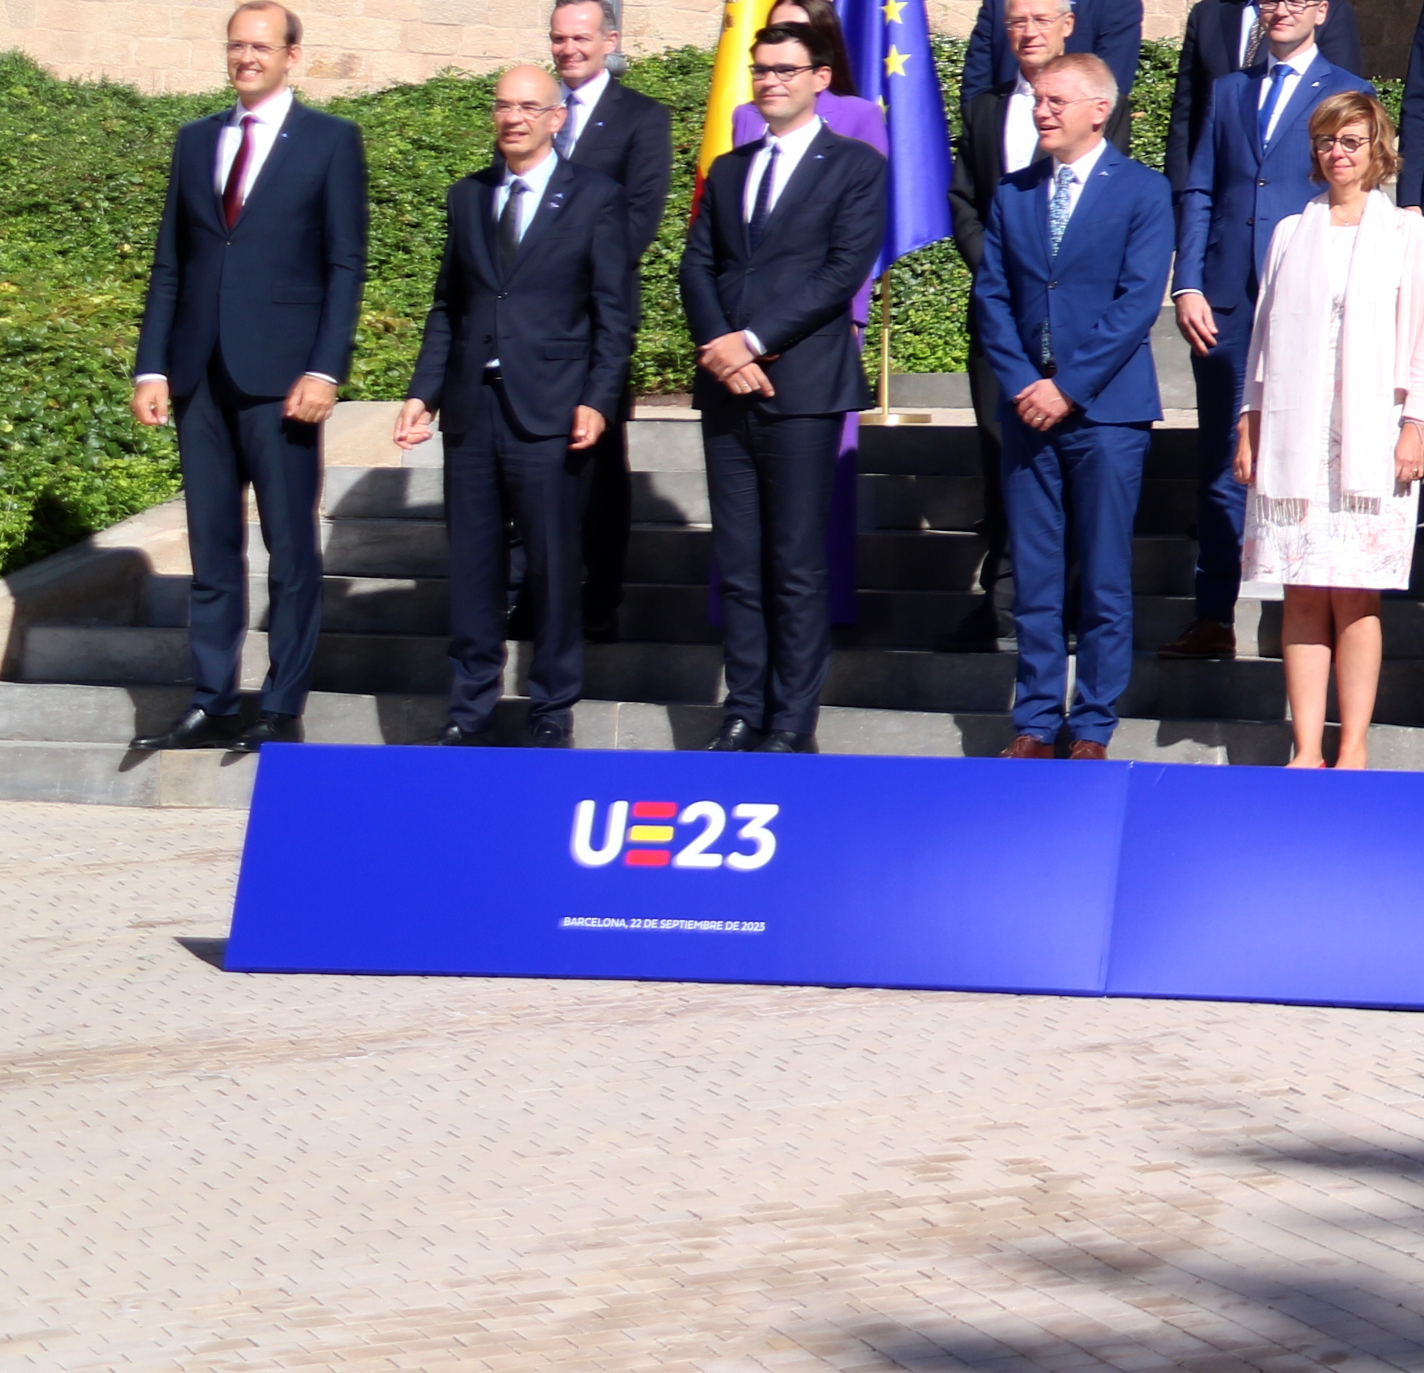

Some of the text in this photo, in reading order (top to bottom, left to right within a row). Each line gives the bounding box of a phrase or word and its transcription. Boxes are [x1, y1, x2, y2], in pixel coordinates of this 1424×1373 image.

[571, 799, 780, 870] UE23
[562, 916, 766, 932] BARCELONA, 22 DE SEPTIEMBRE DE 2023
